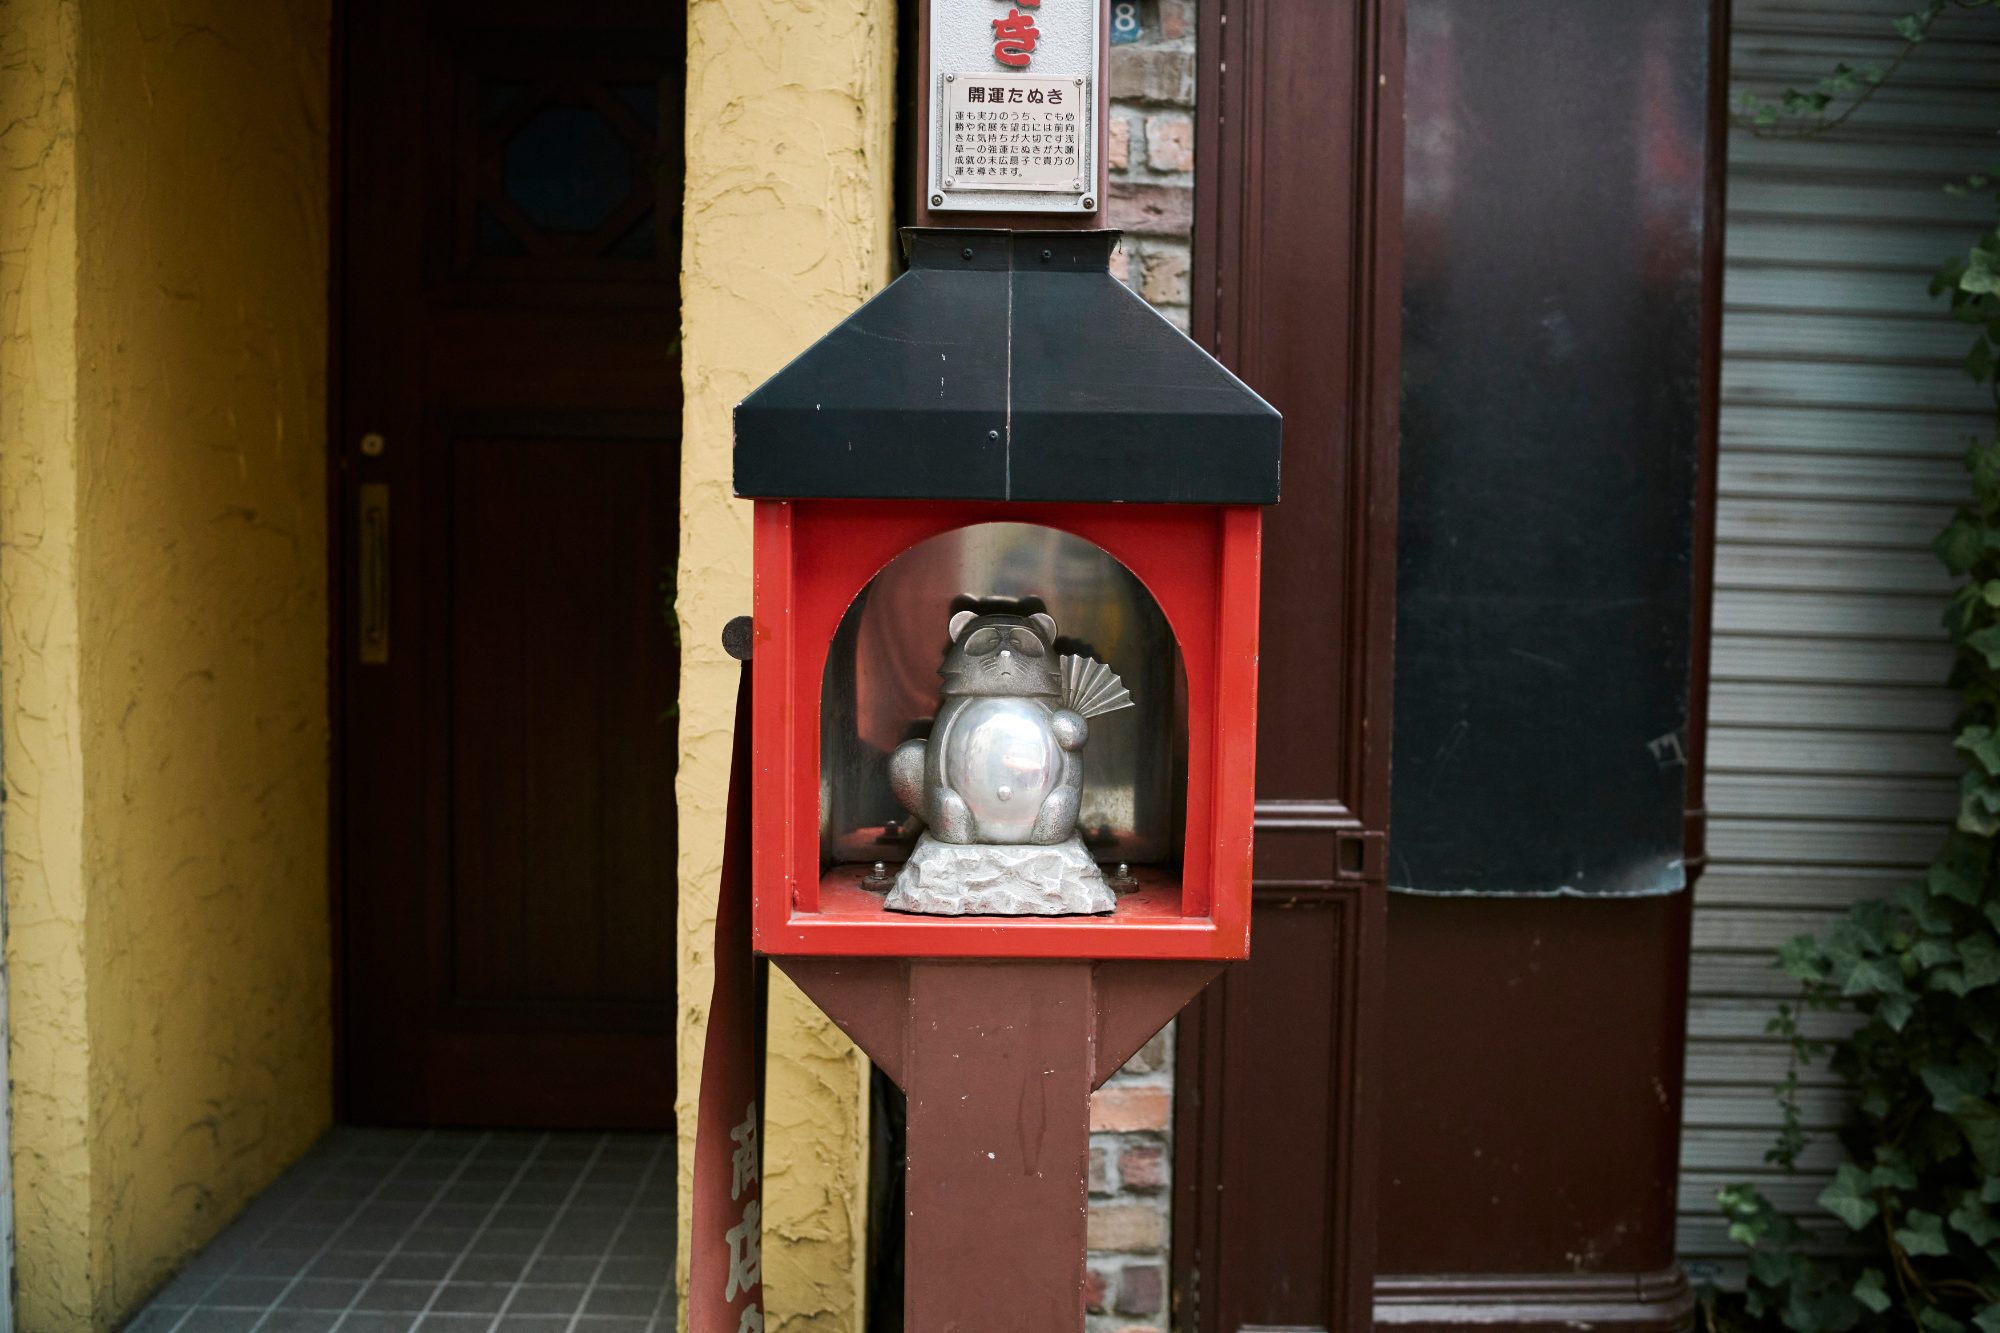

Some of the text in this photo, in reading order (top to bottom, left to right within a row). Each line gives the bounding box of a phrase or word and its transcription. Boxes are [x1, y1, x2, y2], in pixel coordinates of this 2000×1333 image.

[1114, 3, 1136, 31] 8
[991, 0, 1041, 67] き
[968, 86, 1063, 105] 開運たぬき
[954, 111, 1075, 121] 運も実力のうち、でも必
[954, 122, 1075, 132] 勝や発展を望むには前向
[954, 133, 1075, 144] きな気持ちが大切です浅
[954, 155, 1075, 166] 成就の末広扇子で貴方の
[954, 166, 1023, 178] 運を導きます。
